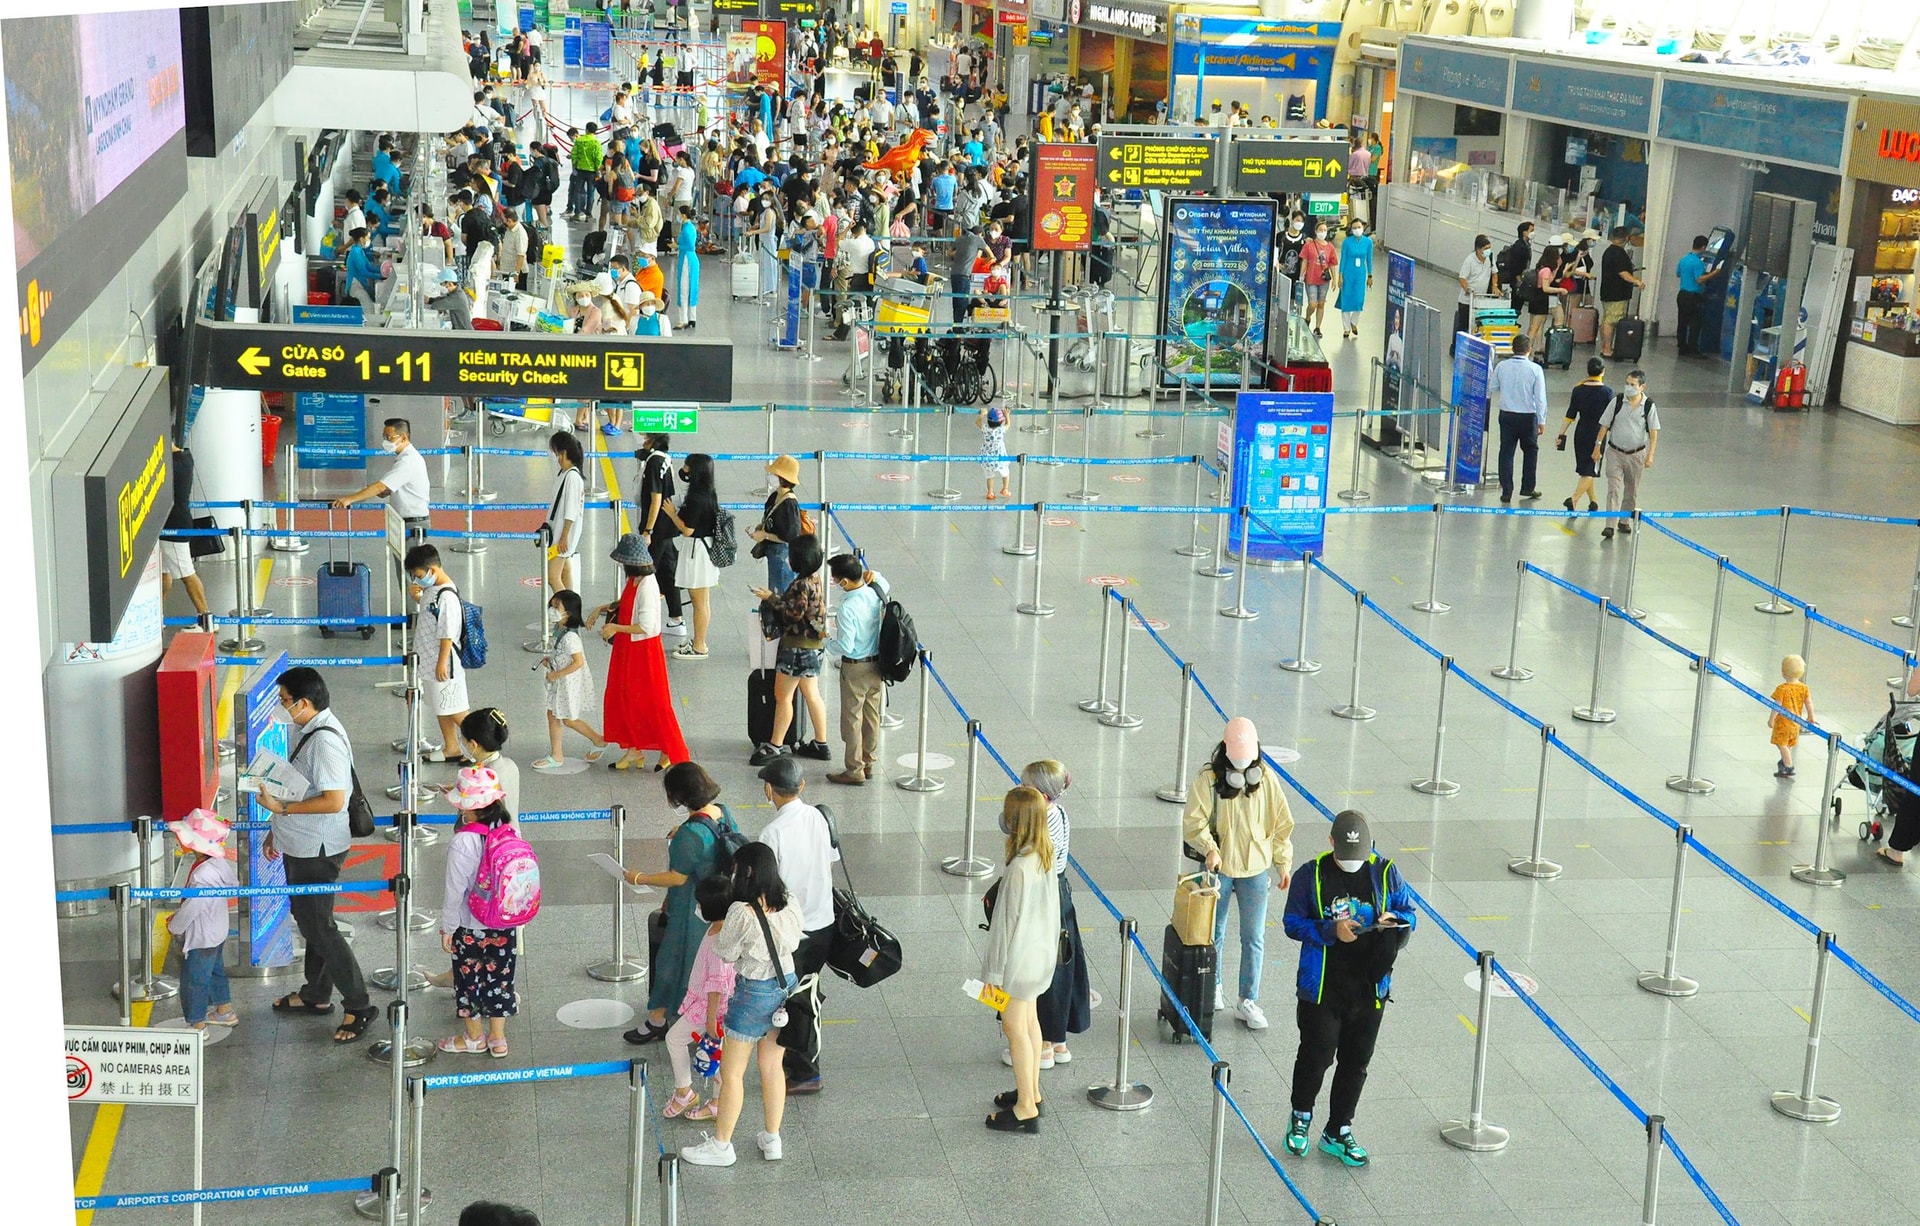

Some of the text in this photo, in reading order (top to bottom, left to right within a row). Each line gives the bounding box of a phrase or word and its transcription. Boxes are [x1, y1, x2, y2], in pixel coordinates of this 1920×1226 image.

[1090, 6, 1157, 31] HIGHLANDS COFFEE
[1237, 55, 1274, 66] Airlines
[1144, 145, 1165, 153] PHÒNG
[1166, 144, 1179, 153] CHỜ
[1144, 177, 1169, 185] Security
[1315, 202, 1328, 212] EXIT
[1223, 243, 1249, 255] Villas
[282, 342, 318, 361] CỬA
[501, 352, 533, 366] TRA
[534, 353, 557, 367] AN
[560, 354, 597, 368] NINH
[282, 364, 327, 378] Gates
[459, 369, 568, 386] Security Check
[520, 812, 538, 821] CẢNG
[540, 812, 560, 820] HÀNG
[561, 811, 585, 820] KHÔNG
[586, 811, 601, 819] VIỆT
[199, 887, 238, 897] AIRPORTS
[239, 886, 294, 895] CORPORATION
[308, 885, 342, 893] VIETNAM
[82, 1036, 99, 1052] CẤM
[102, 1041, 123, 1053] QUAY
[126, 1042, 148, 1056] PHIM,
[150, 1043, 172, 1058] CHỤP
[174, 1039, 190, 1055] ẢNH
[100, 1062, 190, 1075] NO CAMERAS AREA
[460, 1070, 521, 1083] CORPORATION
[523, 1069, 534, 1078] OF
[536, 1066, 572, 1078] VIETNAM
[100, 1081, 191, 1096] 禁止拍摄区
[117, 1194, 169, 1205] AIRPORTS
[171, 1189, 245, 1202] CORPORATION
[247, 1188, 261, 1197] OF
[263, 1185, 308, 1196] VIETNAM
